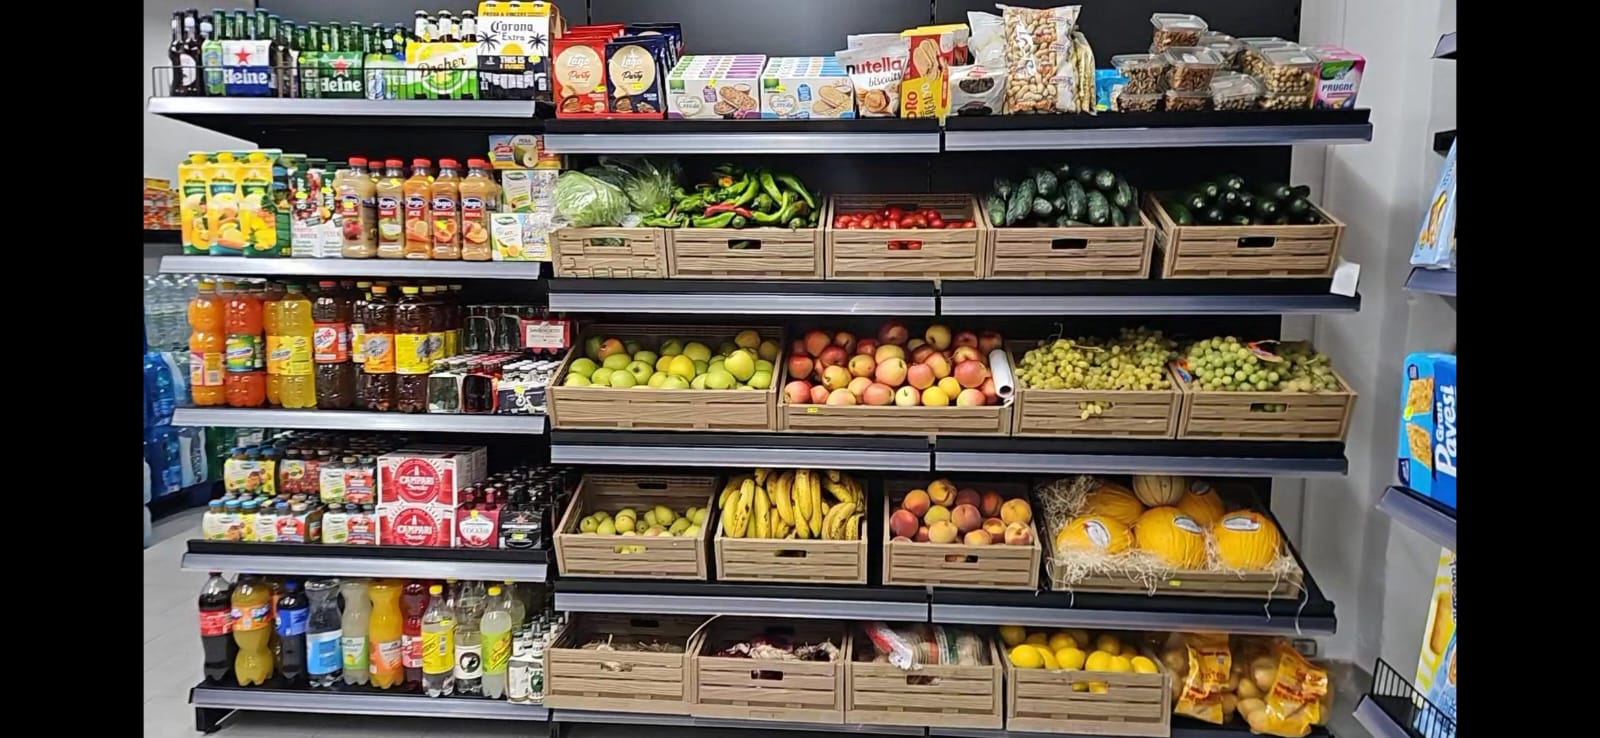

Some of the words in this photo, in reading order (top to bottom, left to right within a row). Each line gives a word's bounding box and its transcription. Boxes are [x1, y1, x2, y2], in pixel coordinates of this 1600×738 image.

[490, 21, 534, 34] Corona
[501, 32, 525, 41] Extra
[846, 57, 902, 75] nutella
[568, 70, 591, 81] Party
[621, 70, 643, 81] Party
[1435, 402, 1444, 442] Gran
[1434, 385, 1457, 478] Pavesi
